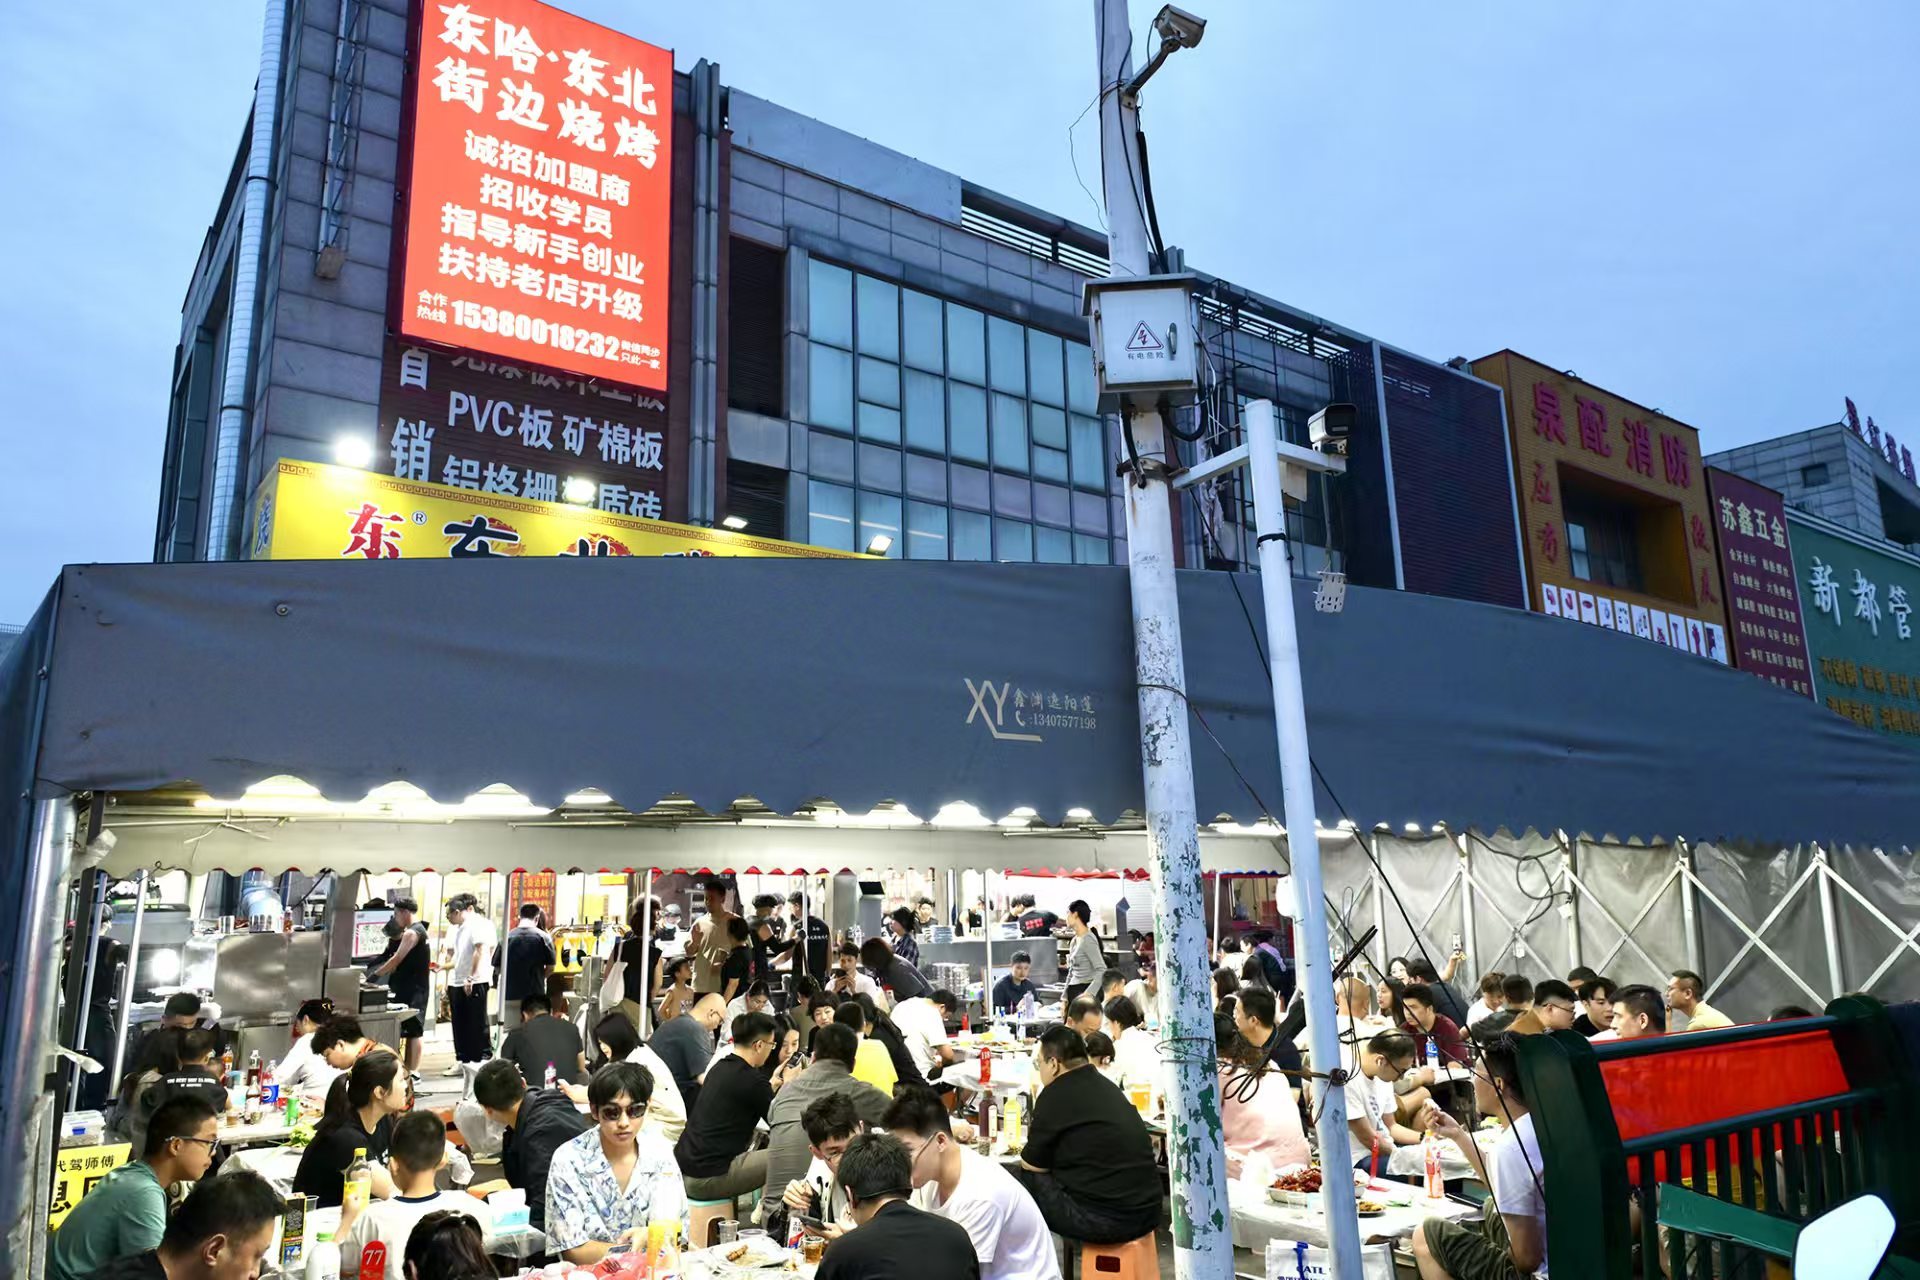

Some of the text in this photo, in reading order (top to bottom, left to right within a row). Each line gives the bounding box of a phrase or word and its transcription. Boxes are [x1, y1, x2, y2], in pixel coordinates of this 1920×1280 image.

[432, 56, 660, 169] 街边烧烤
[464, 130, 630, 206] 诚招加盟商
[480, 173, 613, 239] 招收学员
[441, 202, 645, 285] 指导新手创业
[417, 289, 448, 307] 合作
[438, 242, 643, 323] 扶持老店升级
[416, 305, 448, 325] 热线
[451, 300, 620, 361] 15380018232
[562, 414, 665, 472] 矿棉板
[1533, 381, 1691, 489] 泉配消防
[1719, 496, 1786, 549] 苏鑫五金
[365, 1249, 384, 1265] 77
